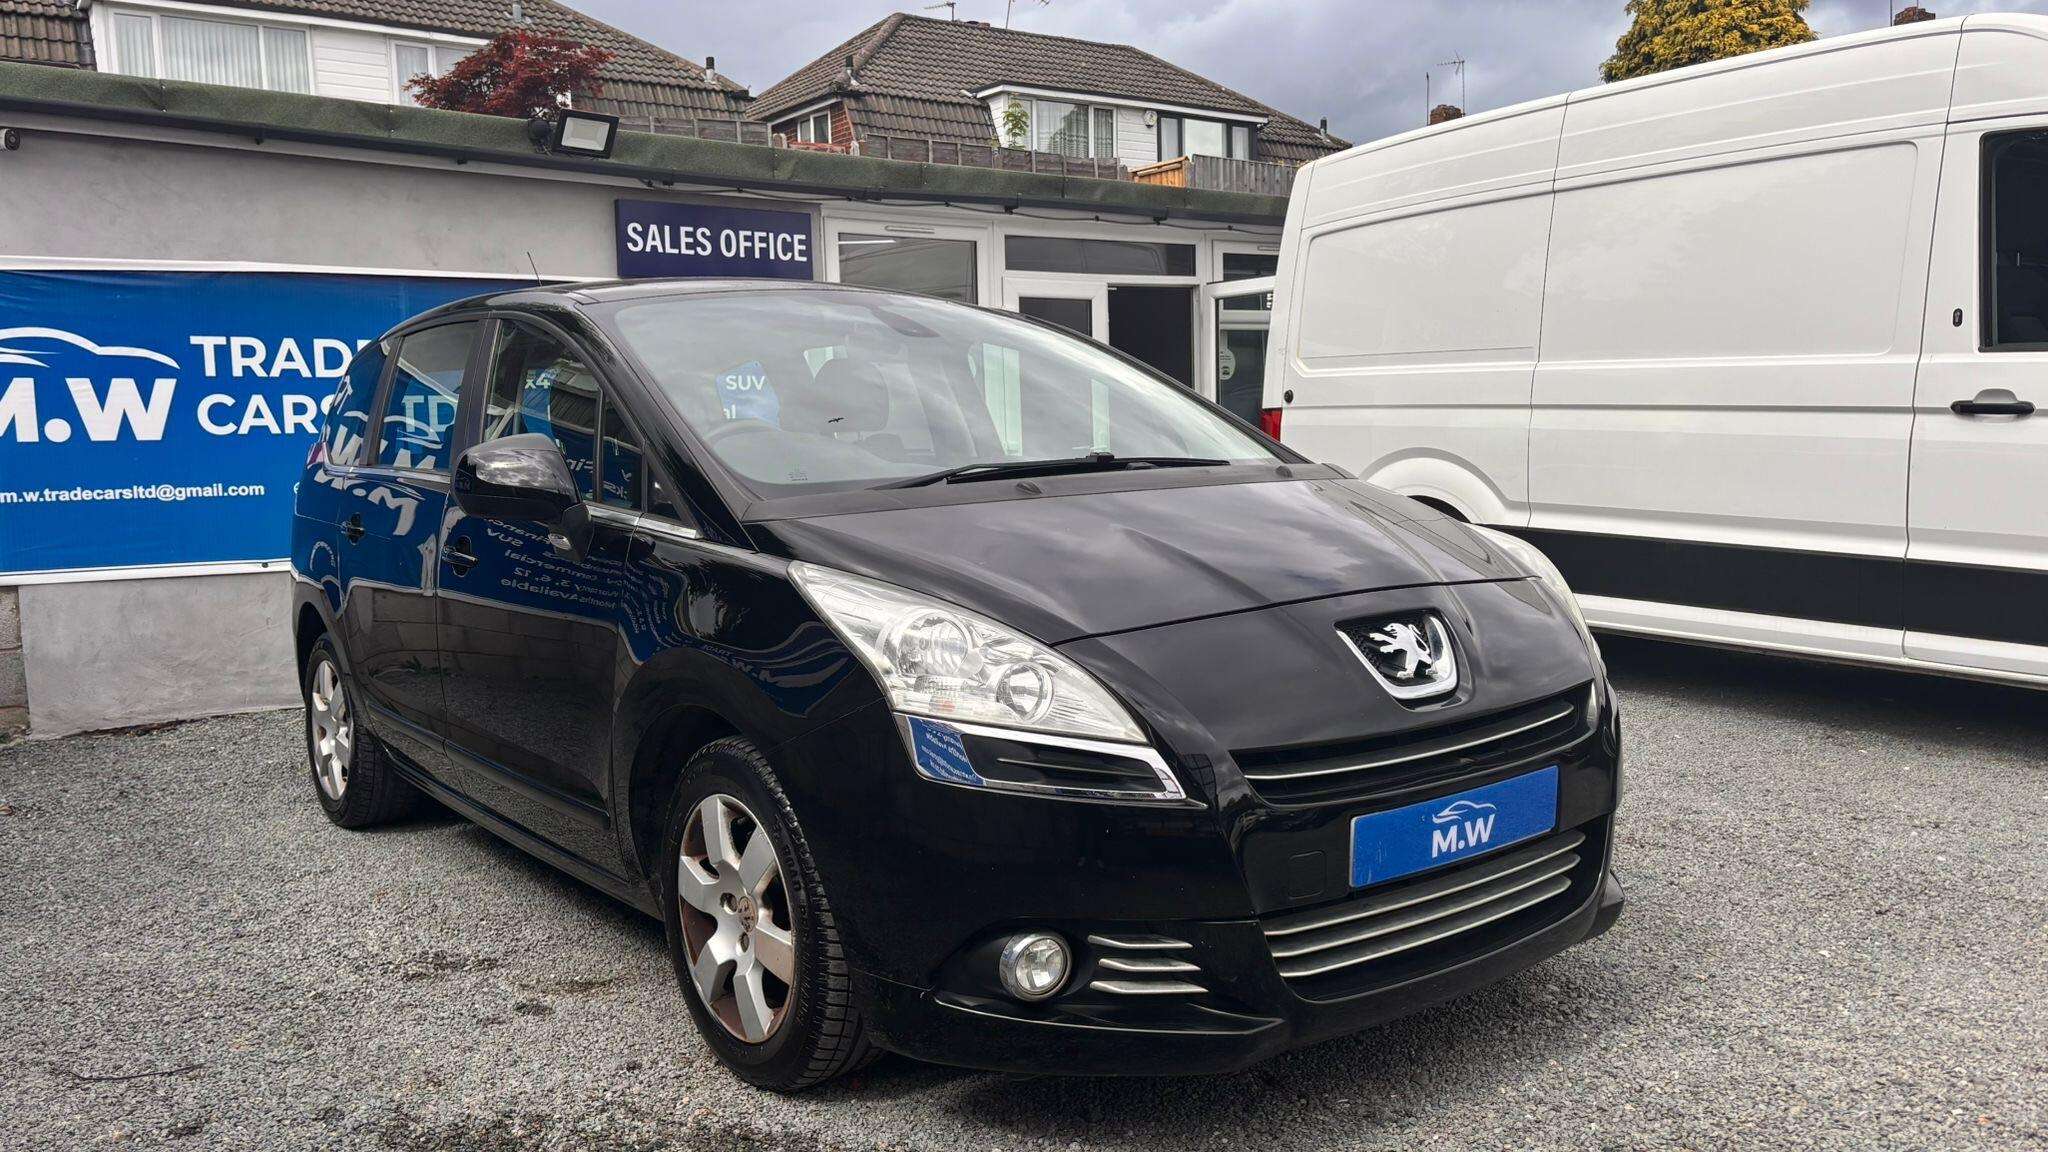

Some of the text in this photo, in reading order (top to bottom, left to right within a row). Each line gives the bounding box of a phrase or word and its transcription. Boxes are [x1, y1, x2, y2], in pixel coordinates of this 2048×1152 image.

[626, 222, 808, 262] SALES OFFICE
[190, 335, 371, 378] TRAD
[725, 375, 765, 391] SUV
[0, 484, 265, 504] m.w.tradecarsltd@gmail.com
[1431, 813, 1495, 858] M.W
